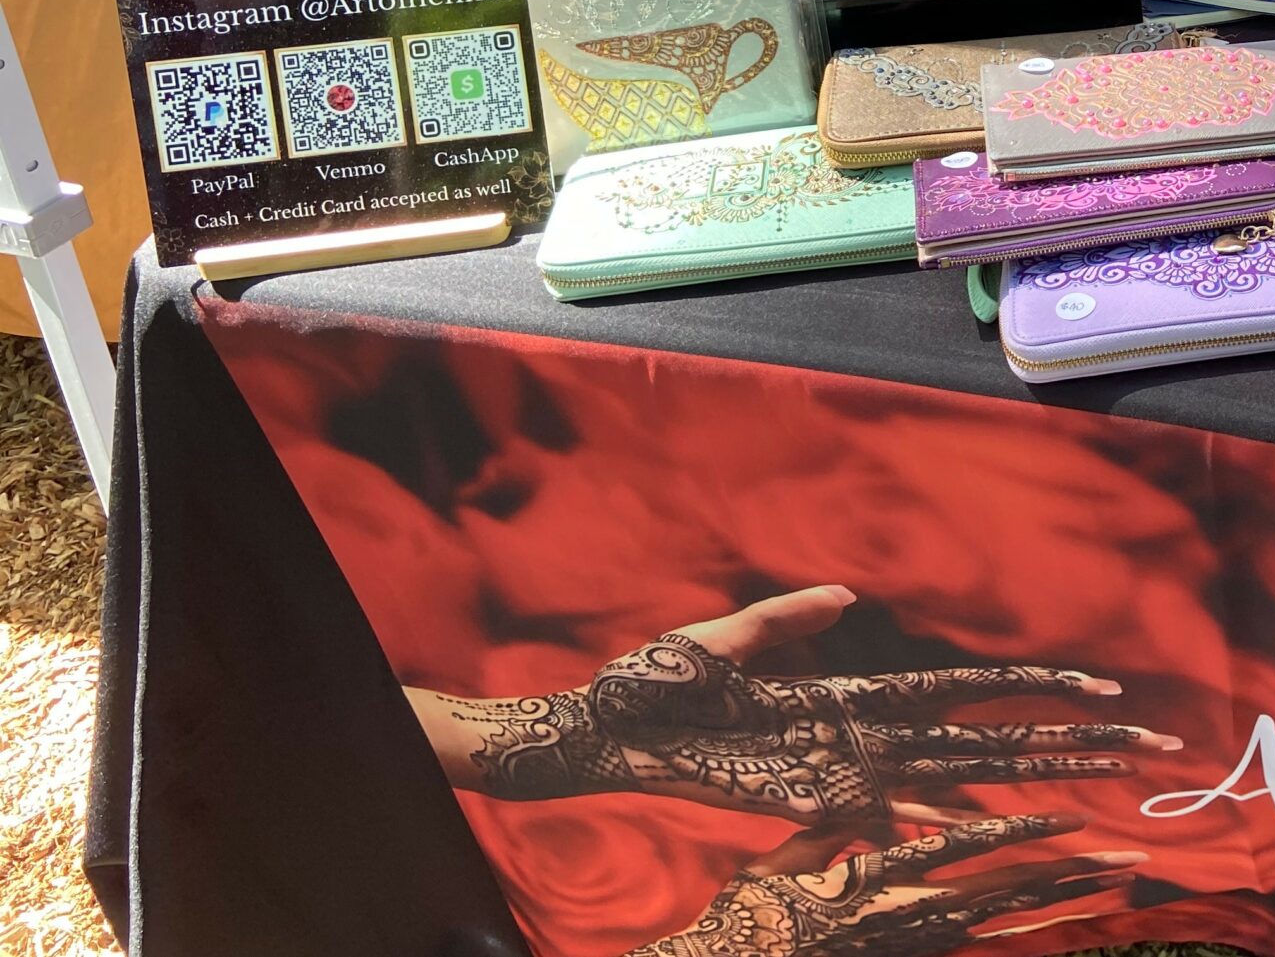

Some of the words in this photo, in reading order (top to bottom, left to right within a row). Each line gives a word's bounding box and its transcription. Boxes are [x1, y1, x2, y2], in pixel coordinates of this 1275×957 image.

[138, 3, 293, 35] Instagram
[191, 172, 255, 196] PayPal
[315, 162, 386, 181] Venmo
[434, 146, 519, 168] CashApp
[195, 211, 239, 229] Cash
[259, 202, 317, 222] Credit
[321, 195, 365, 214] Card
[370, 186, 449, 209] accepted
[454, 187, 472, 200] as
[475, 179, 512, 196] well
